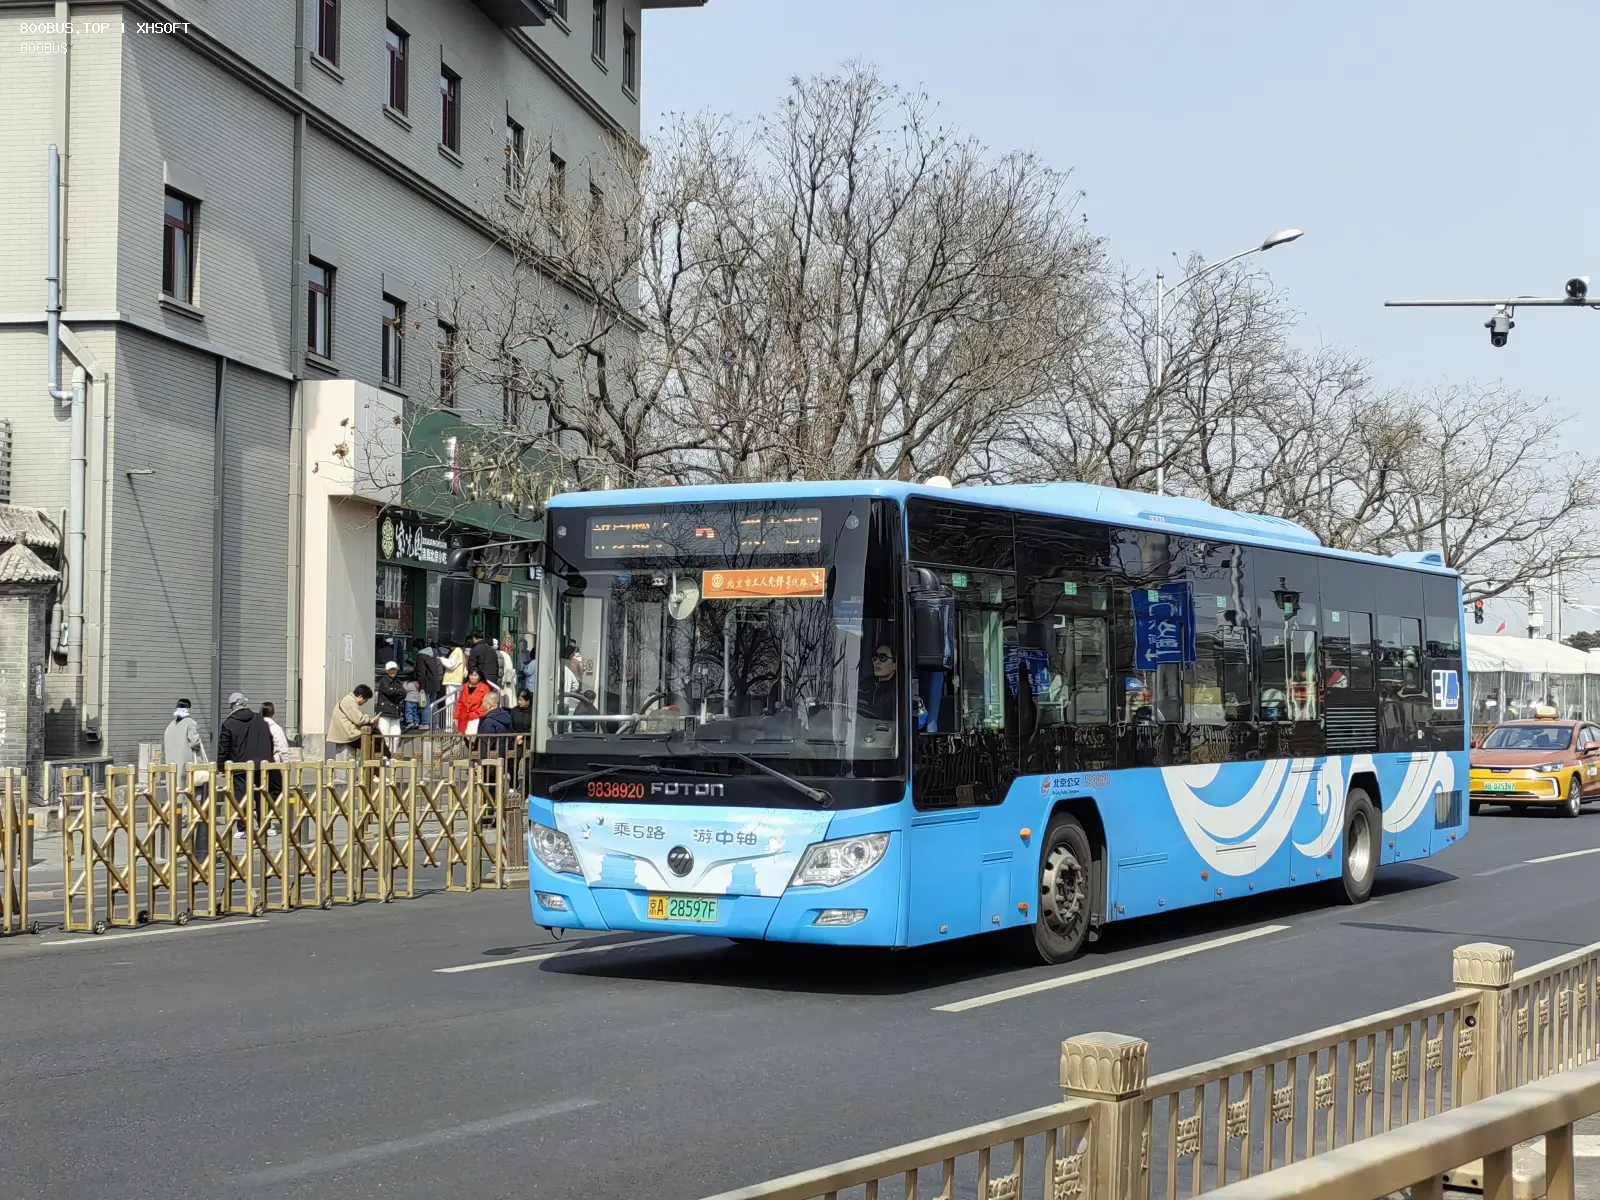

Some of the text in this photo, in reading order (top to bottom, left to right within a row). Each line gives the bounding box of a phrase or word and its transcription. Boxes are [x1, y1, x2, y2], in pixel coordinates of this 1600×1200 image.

[588, 781, 645, 799] 9838920
[651, 782, 724, 797] FOTON
[1053, 777, 1081, 789] 北京公交
[613, 822, 758, 846] 乘5路 游中轴
